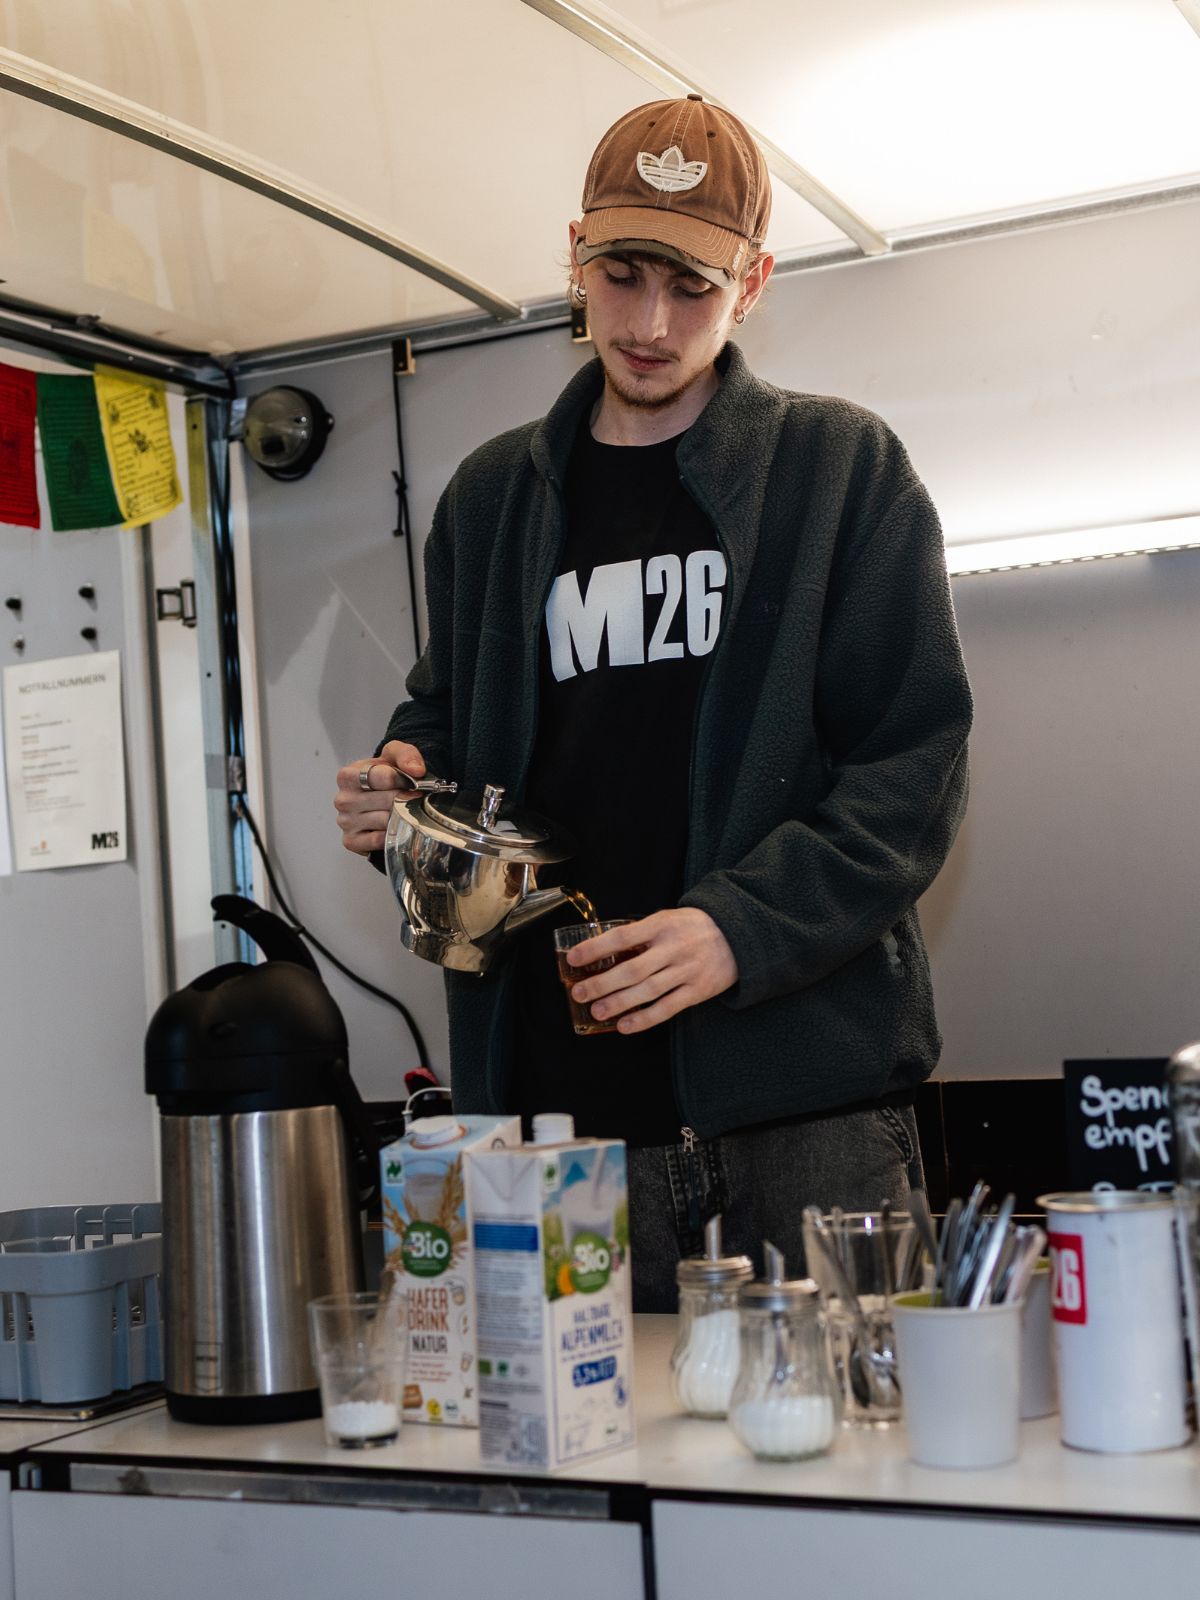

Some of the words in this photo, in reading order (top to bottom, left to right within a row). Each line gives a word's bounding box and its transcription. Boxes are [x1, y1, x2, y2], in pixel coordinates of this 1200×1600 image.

[545, 550, 727, 683] M26
[19, 673, 107, 695] NOTFALLNUMMERN
[410, 1230, 449, 1259] Bio
[575, 1241, 610, 1275] Bio
[406, 1286, 448, 1311] HAFER
[407, 1307, 450, 1332] DRINK
[412, 1335, 447, 1354] NATUR
